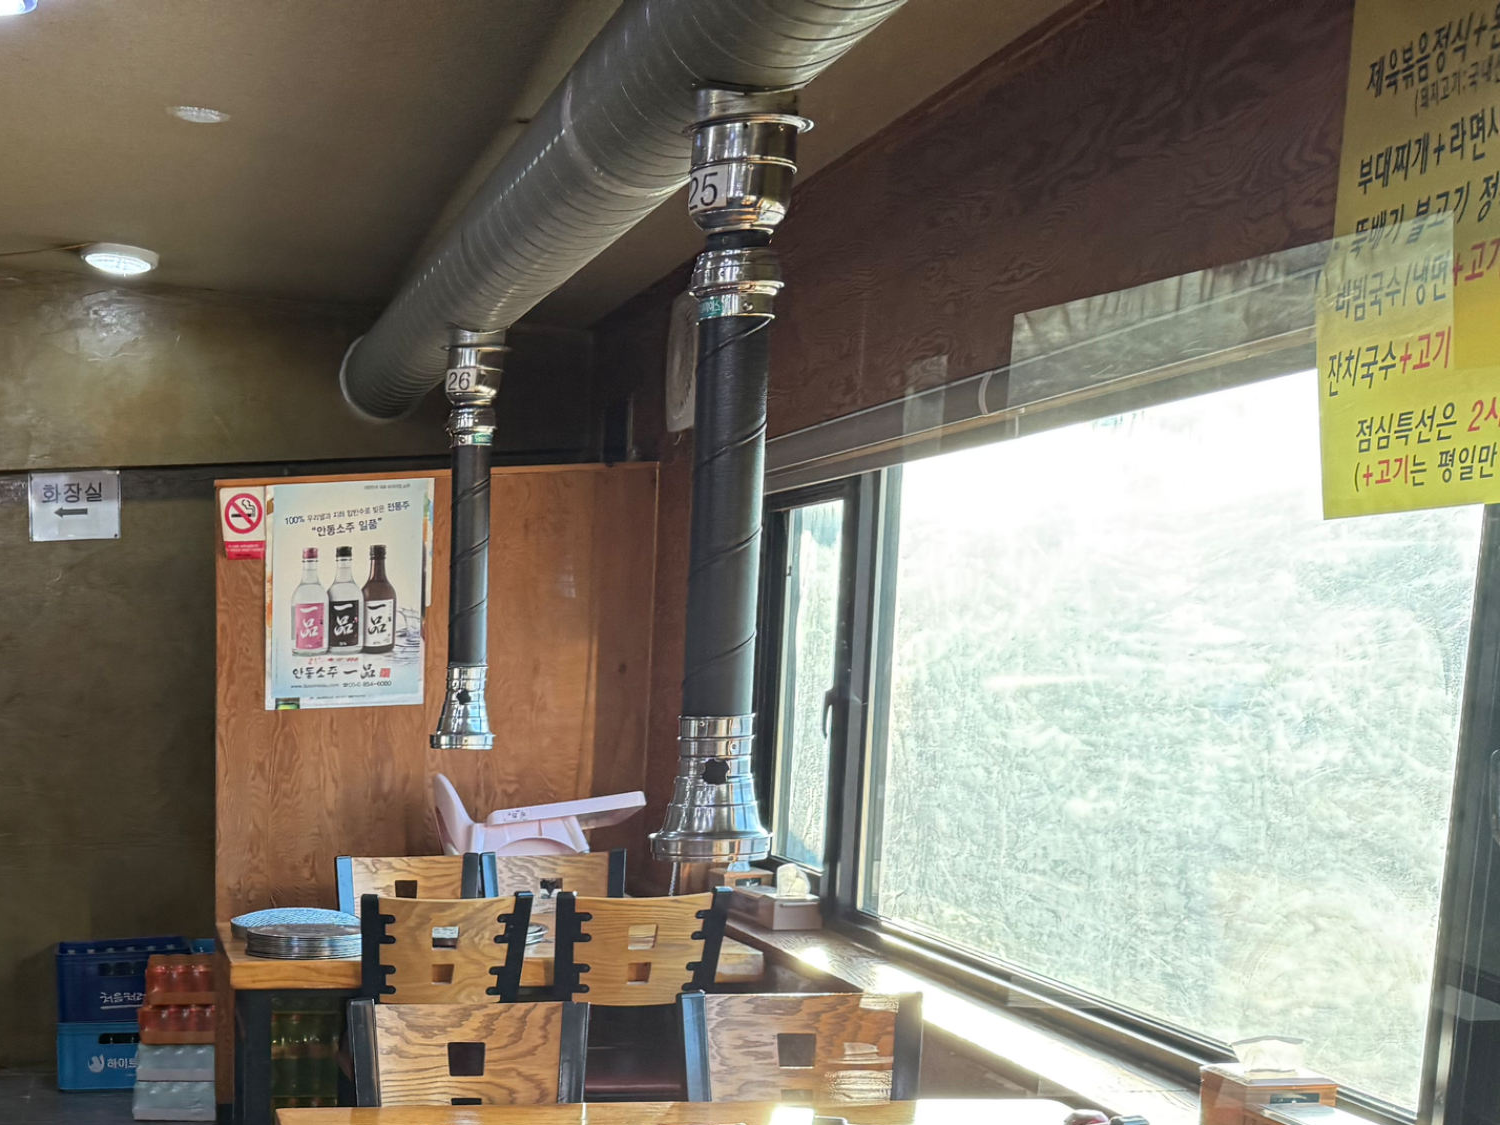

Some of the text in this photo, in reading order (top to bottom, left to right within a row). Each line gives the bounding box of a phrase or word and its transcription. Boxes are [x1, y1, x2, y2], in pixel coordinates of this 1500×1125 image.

[689, 171, 718, 210] 25
[1405, 181, 1470, 245] 불고기
[1477, 171, 1500, 222] 정
[448, 371, 470, 391] 26
[1356, 401, 1457, 454] 점심특선은
[1354, 441, 1498, 493] (+고기는 평일만
[41, 482, 103, 504] 화장실
[284, 514, 305, 525] 100%
[292, 665, 339, 680] 안동소주
